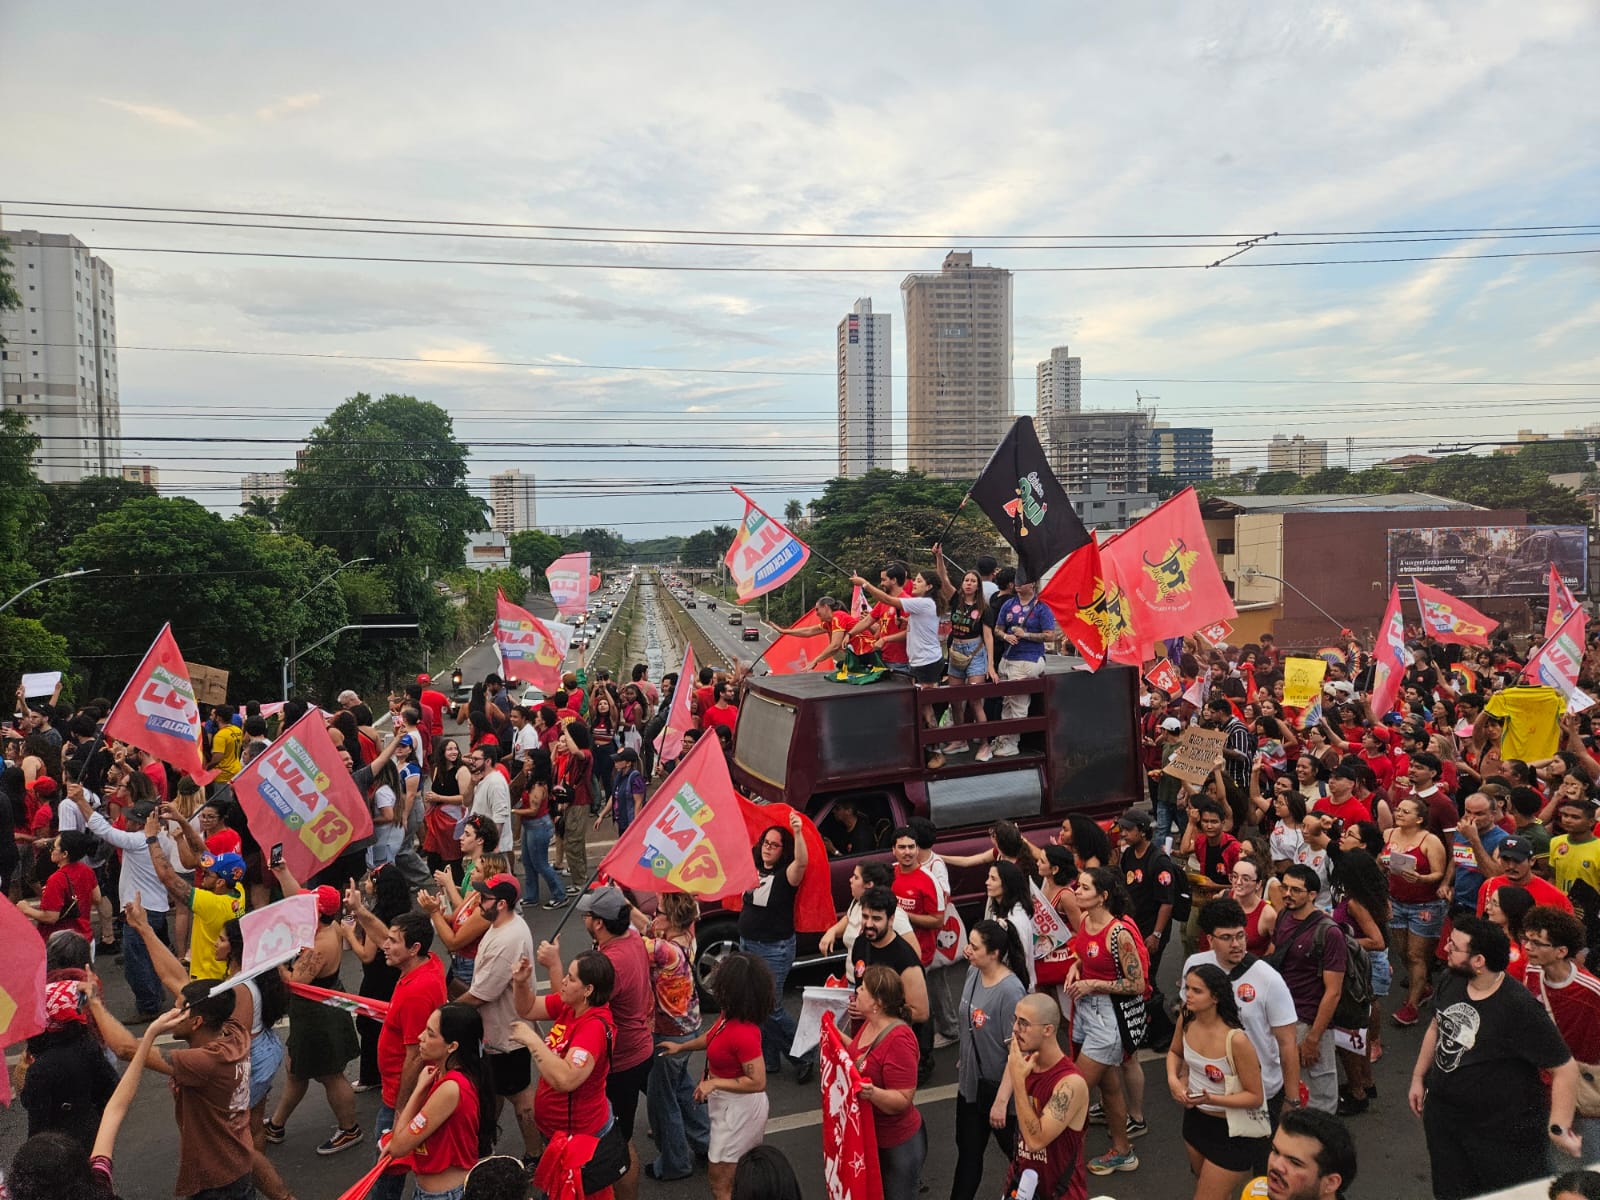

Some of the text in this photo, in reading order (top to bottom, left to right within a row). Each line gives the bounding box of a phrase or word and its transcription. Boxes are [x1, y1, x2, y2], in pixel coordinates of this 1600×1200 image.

[266, 749, 320, 813] LULA
[310, 810, 349, 844] 13
[1350, 1032, 1364, 1049] 13
